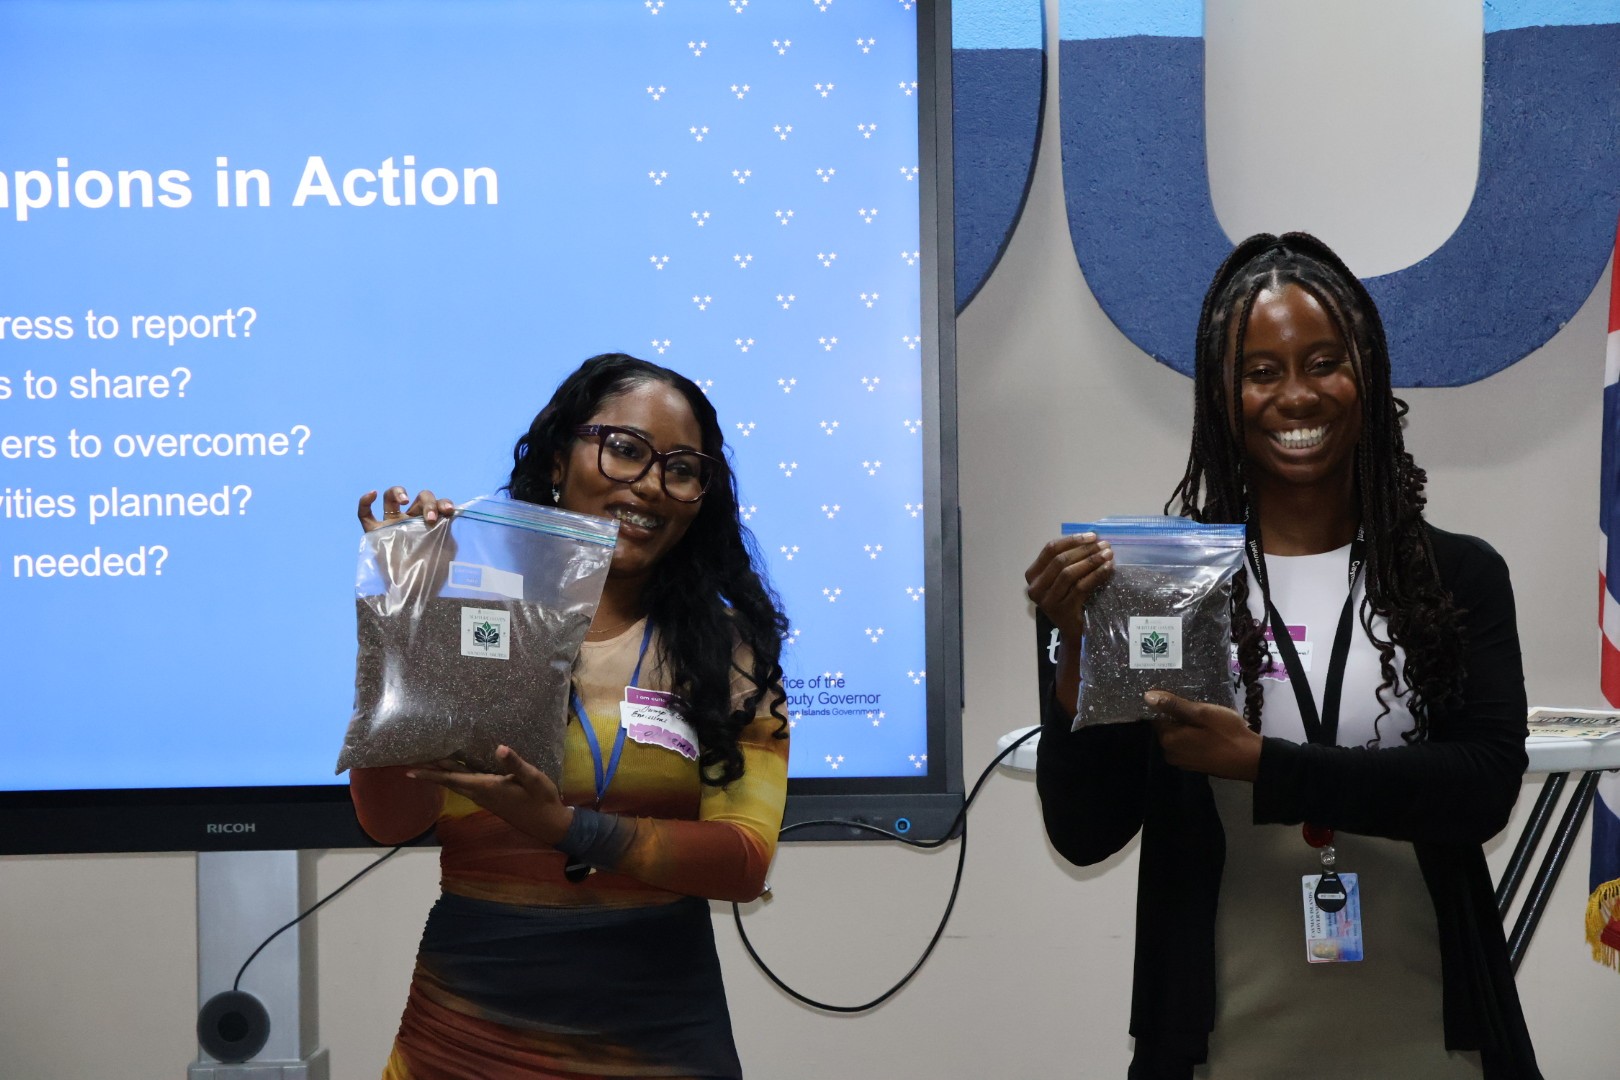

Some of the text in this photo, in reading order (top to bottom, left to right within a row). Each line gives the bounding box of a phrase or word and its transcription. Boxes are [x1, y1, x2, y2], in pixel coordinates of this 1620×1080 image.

[0, 154, 499, 222] pions in Action
[85, 309, 119, 340] to
[131, 306, 257, 346] report?
[23, 369, 57, 400] to
[69, 366, 192, 399] share?
[69, 428, 102, 459] to
[113, 424, 311, 458] overcome?
[0, 484, 253, 525] ities planned?
[13, 544, 169, 578] needed?
[782, 675, 845, 689] fice of the
[787, 691, 881, 708] puty Governor
[802, 708, 829, 716] Islands
[206, 823, 256, 833] RICOH
